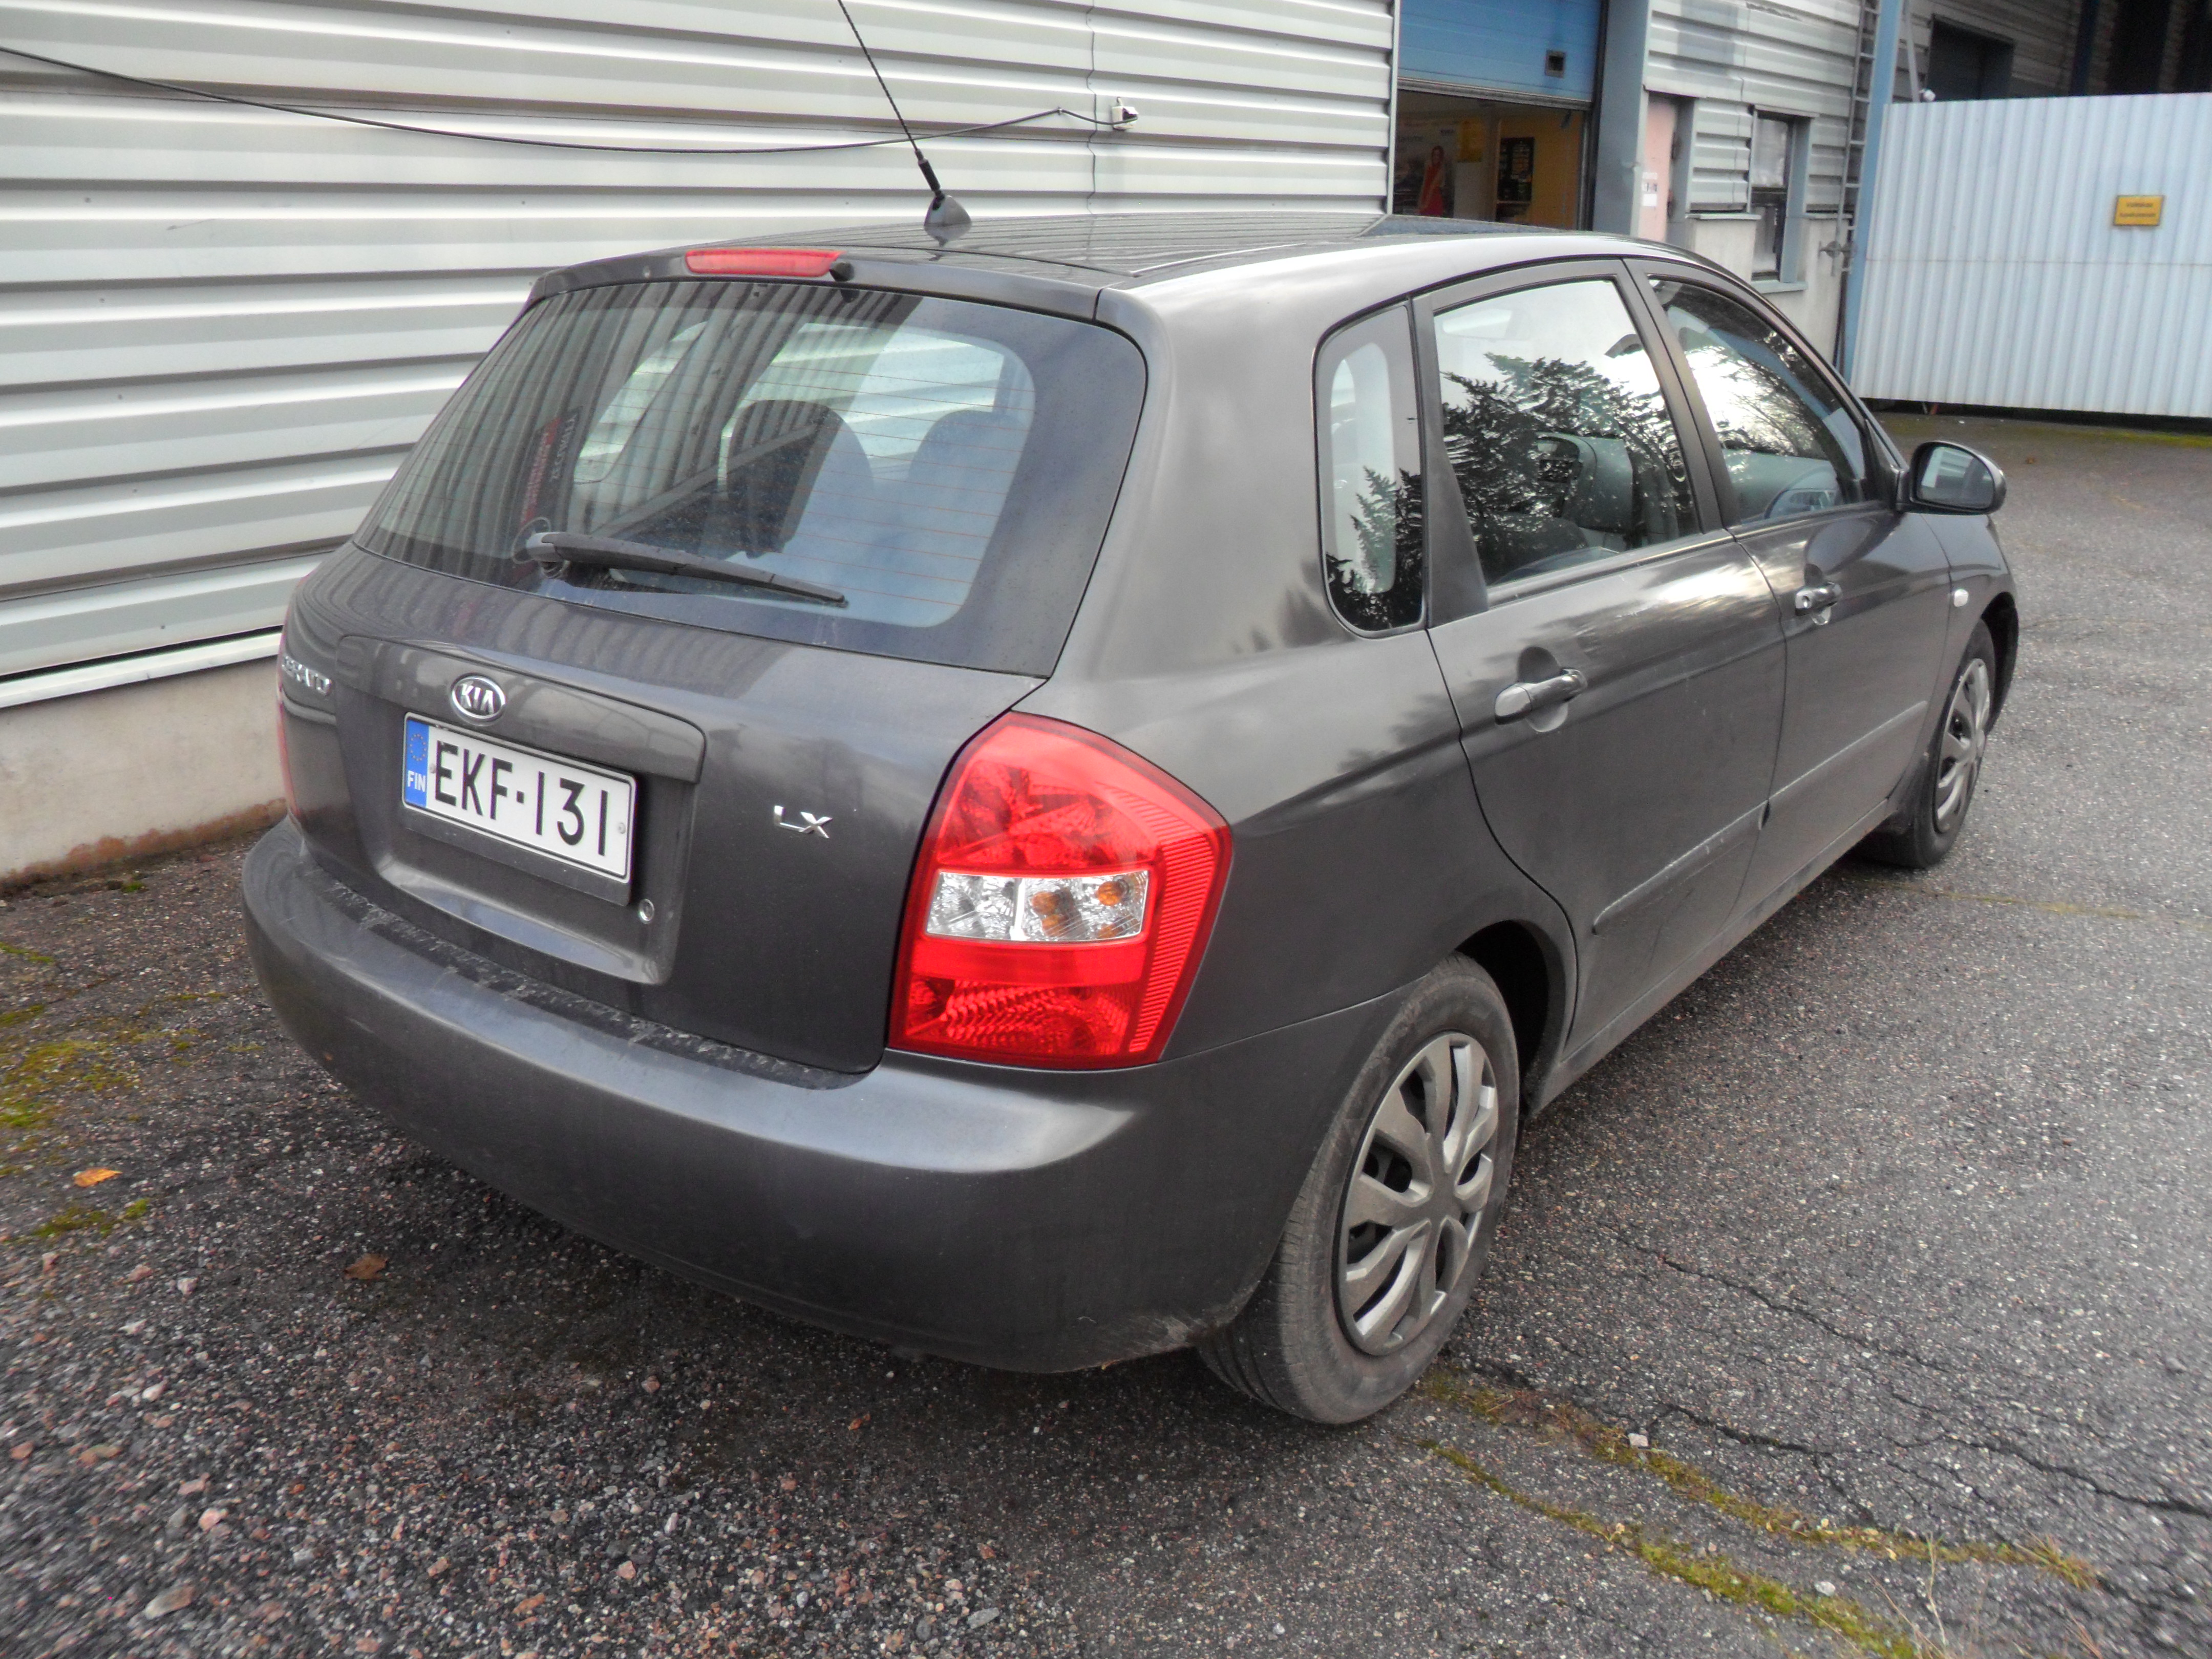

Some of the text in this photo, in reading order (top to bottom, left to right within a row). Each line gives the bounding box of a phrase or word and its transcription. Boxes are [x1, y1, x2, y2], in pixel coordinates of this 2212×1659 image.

[461, 684, 495, 714] KIA
[407, 770, 427, 793] FIN
[435, 740, 609, 856] EKF-131
[773, 805, 833, 839] LX
